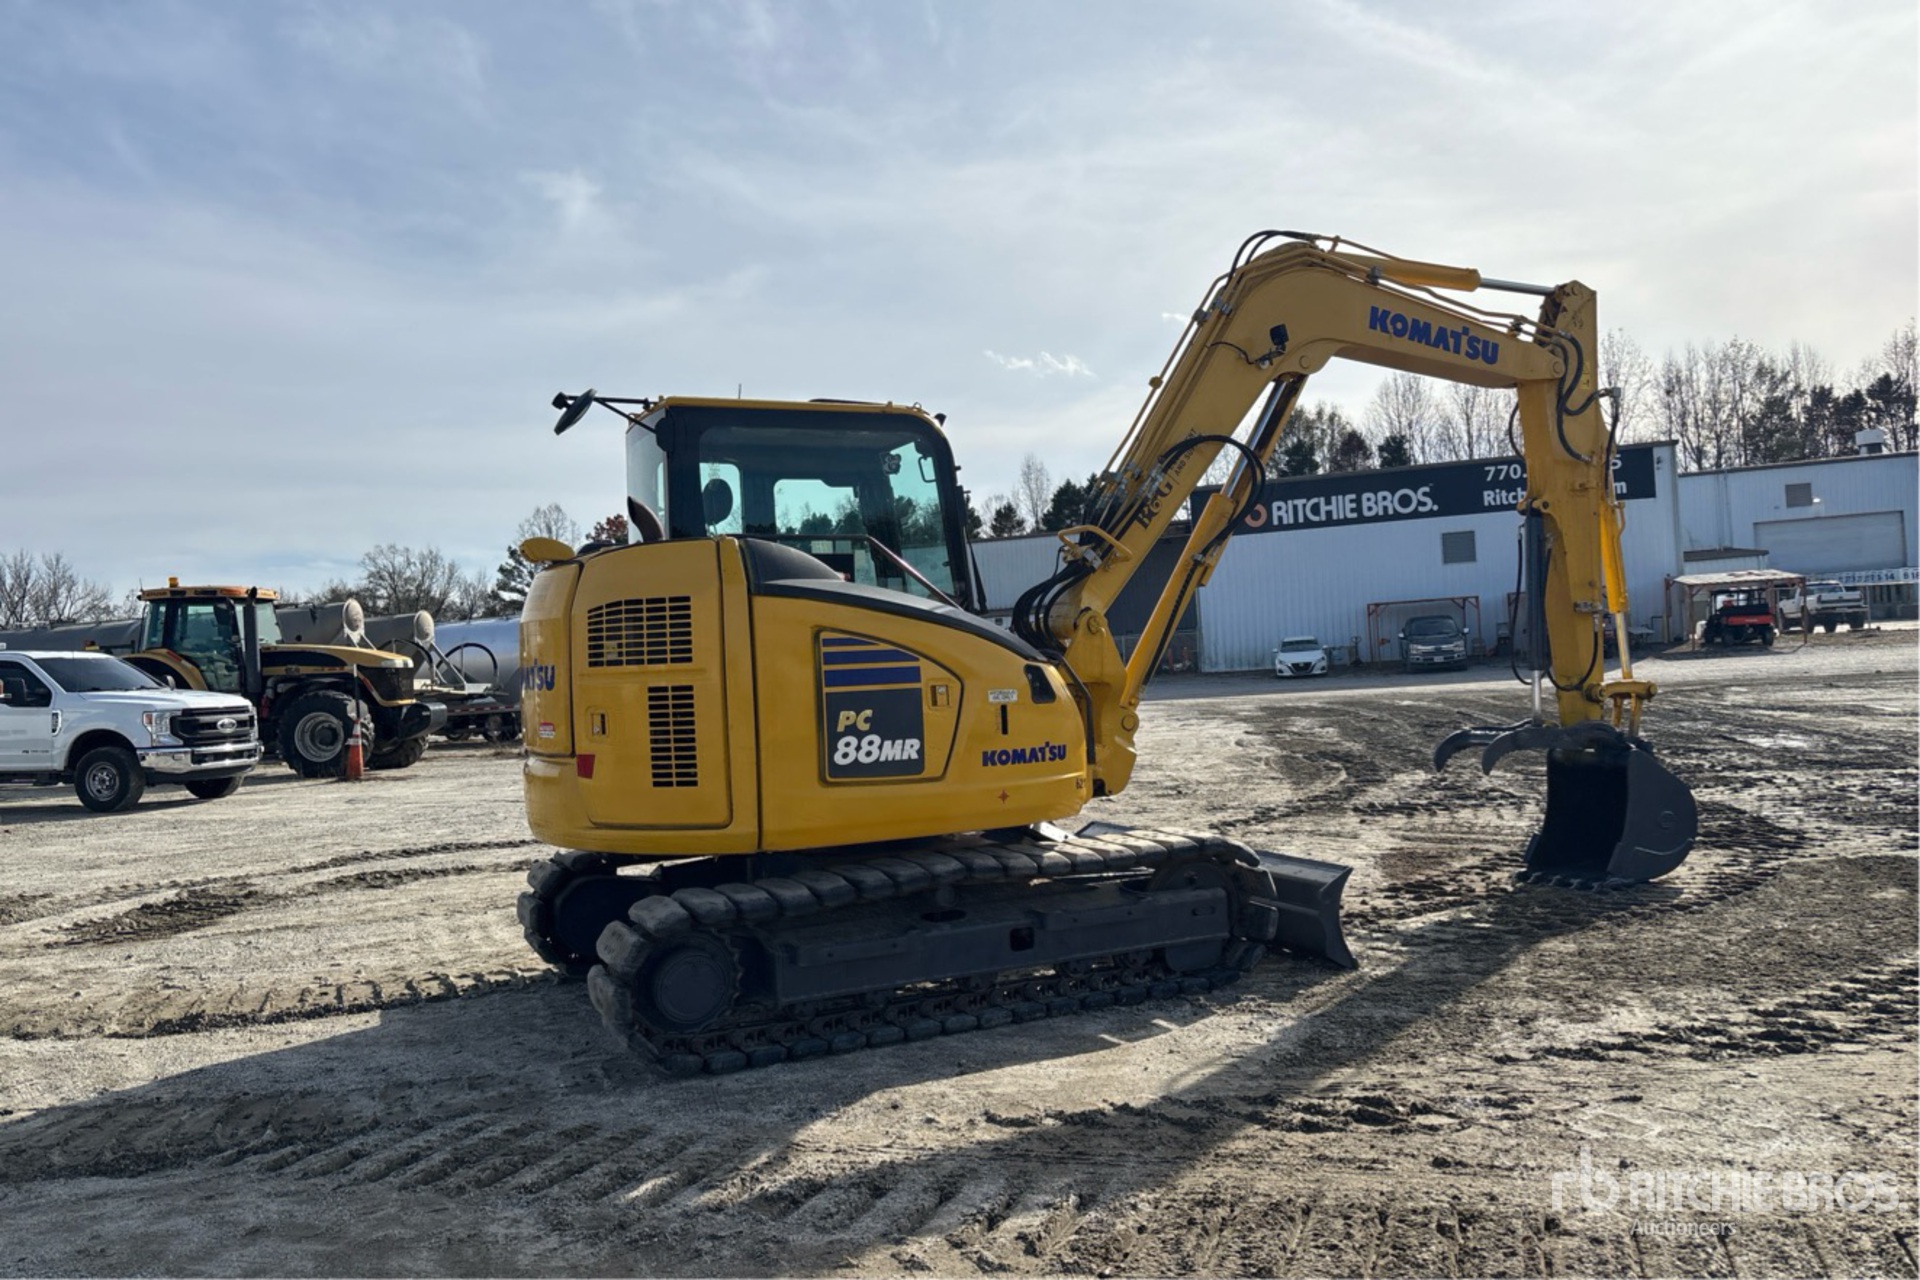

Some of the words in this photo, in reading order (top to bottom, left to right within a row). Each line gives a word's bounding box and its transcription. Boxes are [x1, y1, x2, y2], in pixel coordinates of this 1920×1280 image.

[1369, 305, 1500, 365] KOMATSU
[1271, 493, 1358, 526] RITCHIE
[1361, 486, 1439, 518] BROS.
[837, 709, 873, 733] PC
[833, 733, 921, 766] 88MR
[982, 741, 1067, 767] KOMATSU
